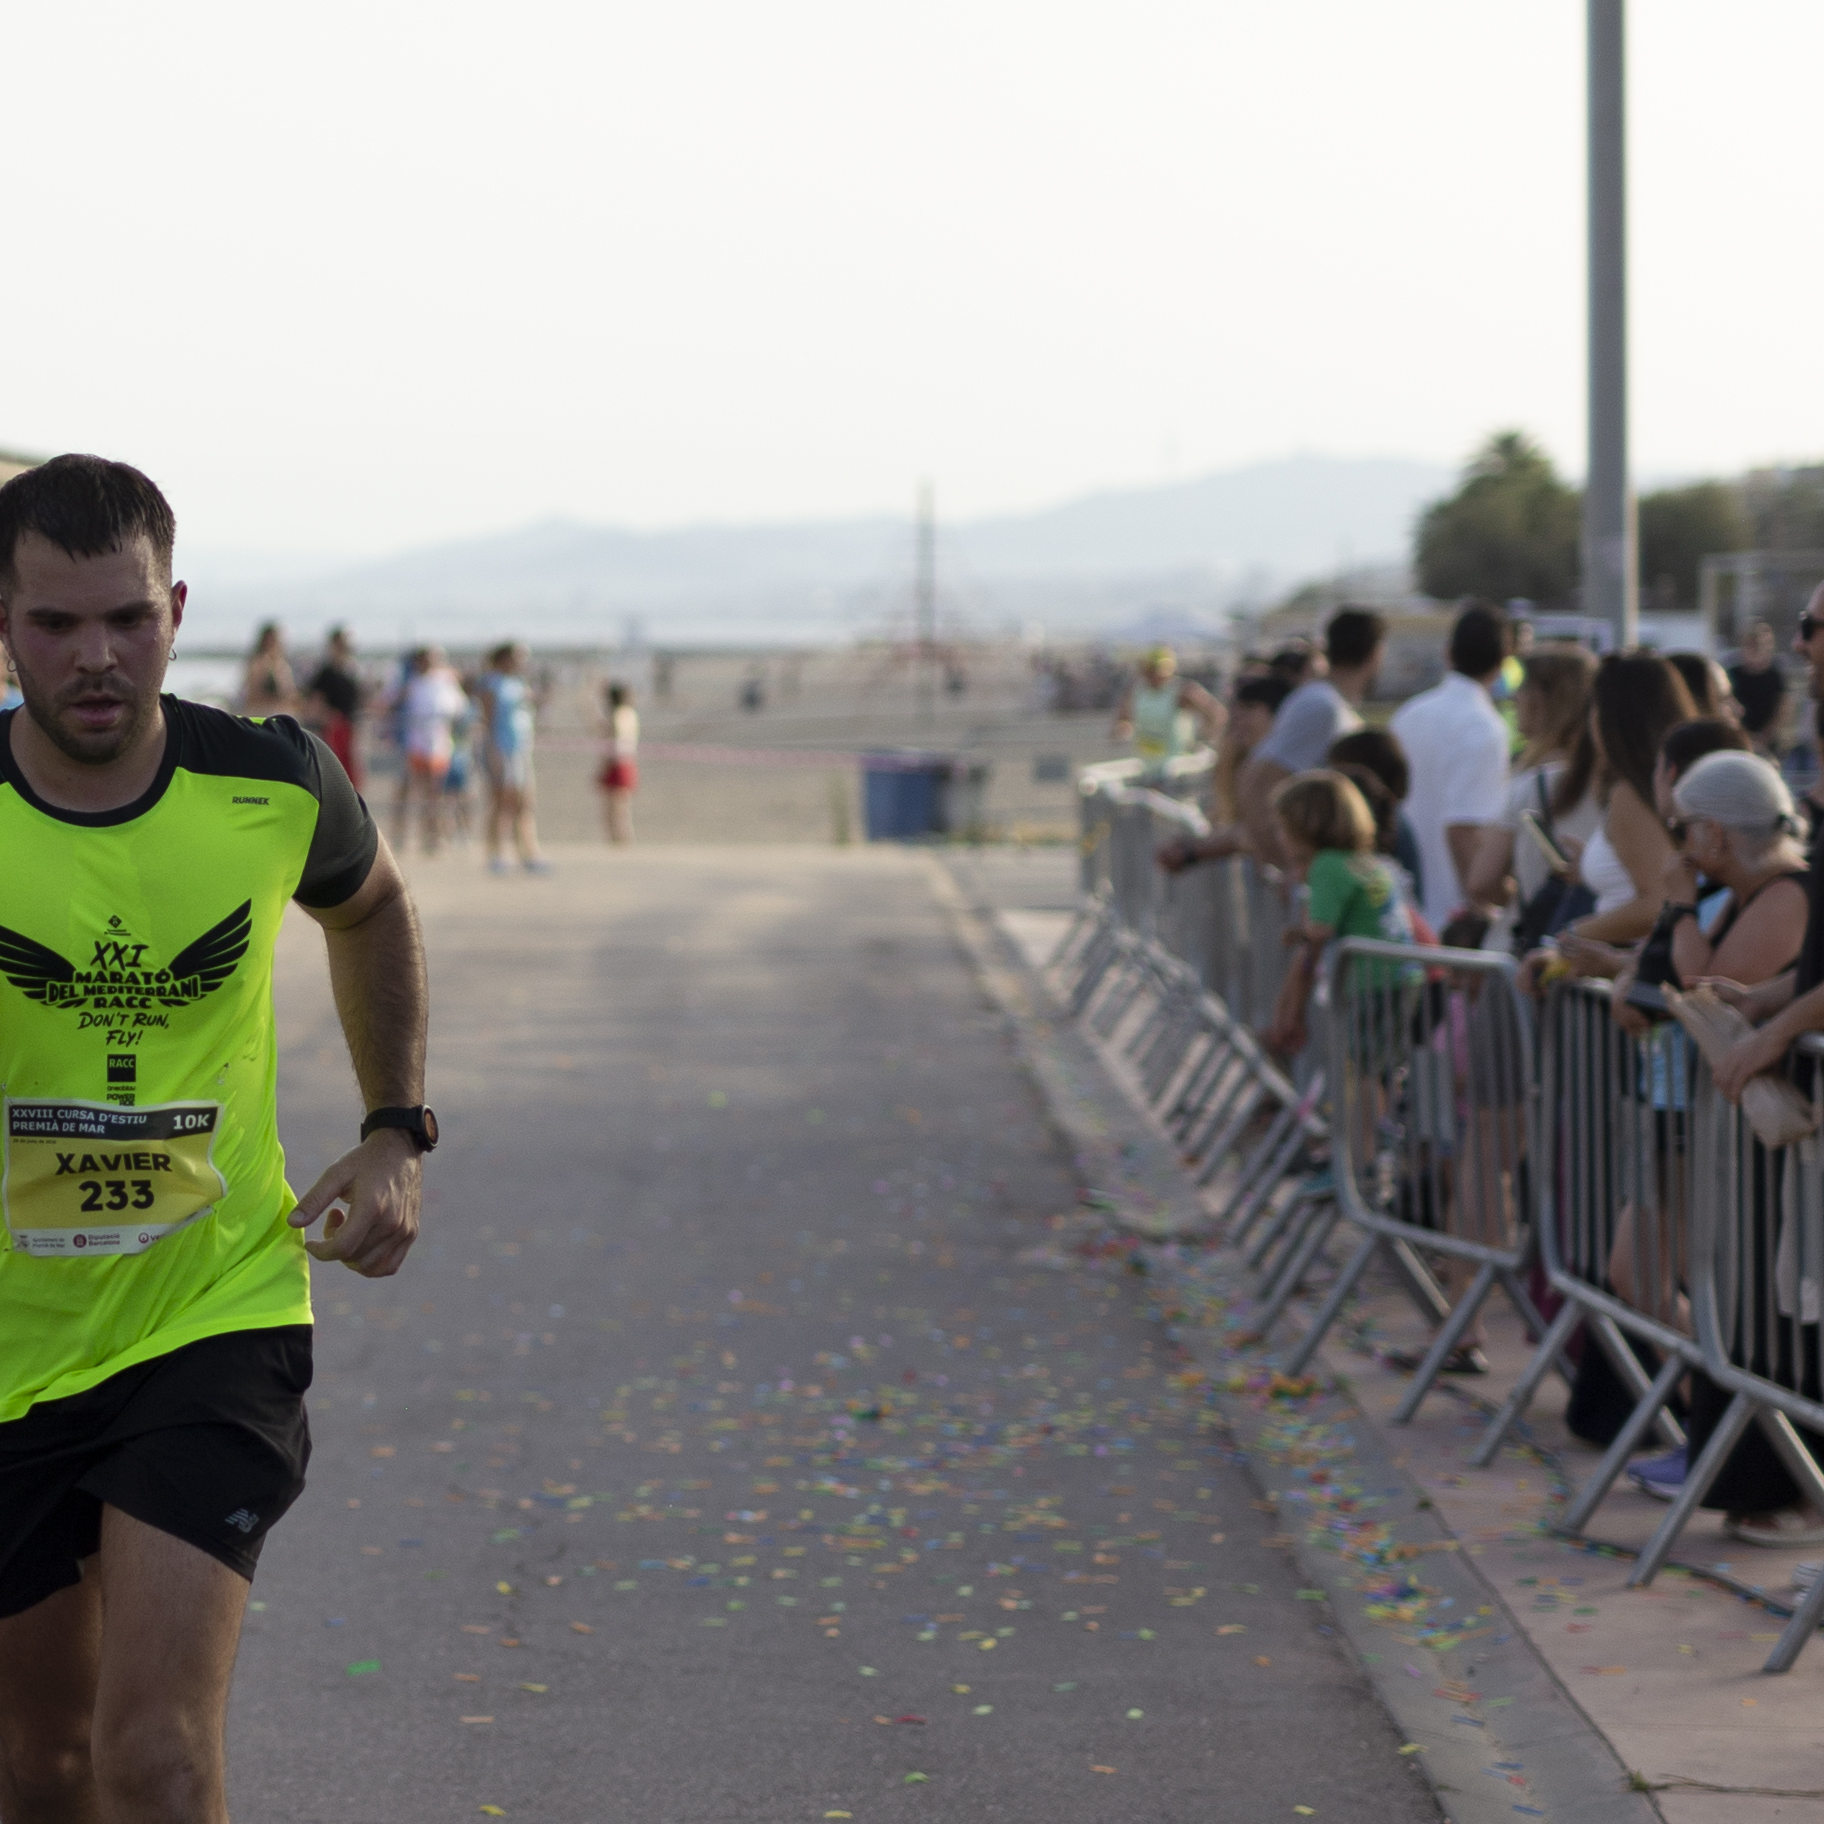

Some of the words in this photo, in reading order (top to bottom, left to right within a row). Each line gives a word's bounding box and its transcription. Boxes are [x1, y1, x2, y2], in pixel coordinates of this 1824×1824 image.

[90, 941, 149, 971] XXI
[75, 968, 171, 985] MARATÓ
[48, 983, 79, 1003] DEL
[83, 976, 199, 998] MEDITERRANI
[93, 996, 152, 1009] RACC
[106, 1029, 143, 1047] FLY!
[109, 1058, 135, 1068] RACC
[12, 1108, 53, 1118] XXVIII
[56, 1109, 95, 1121] CURSA
[173, 1113, 211, 1130] 10K
[12, 1119, 59, 1132] PREMIÀ
[62, 1122, 76, 1132] DE
[79, 1123, 106, 1134] MAR
[55, 1152, 173, 1176] XAVIER
[78, 1179, 155, 1213] 233
